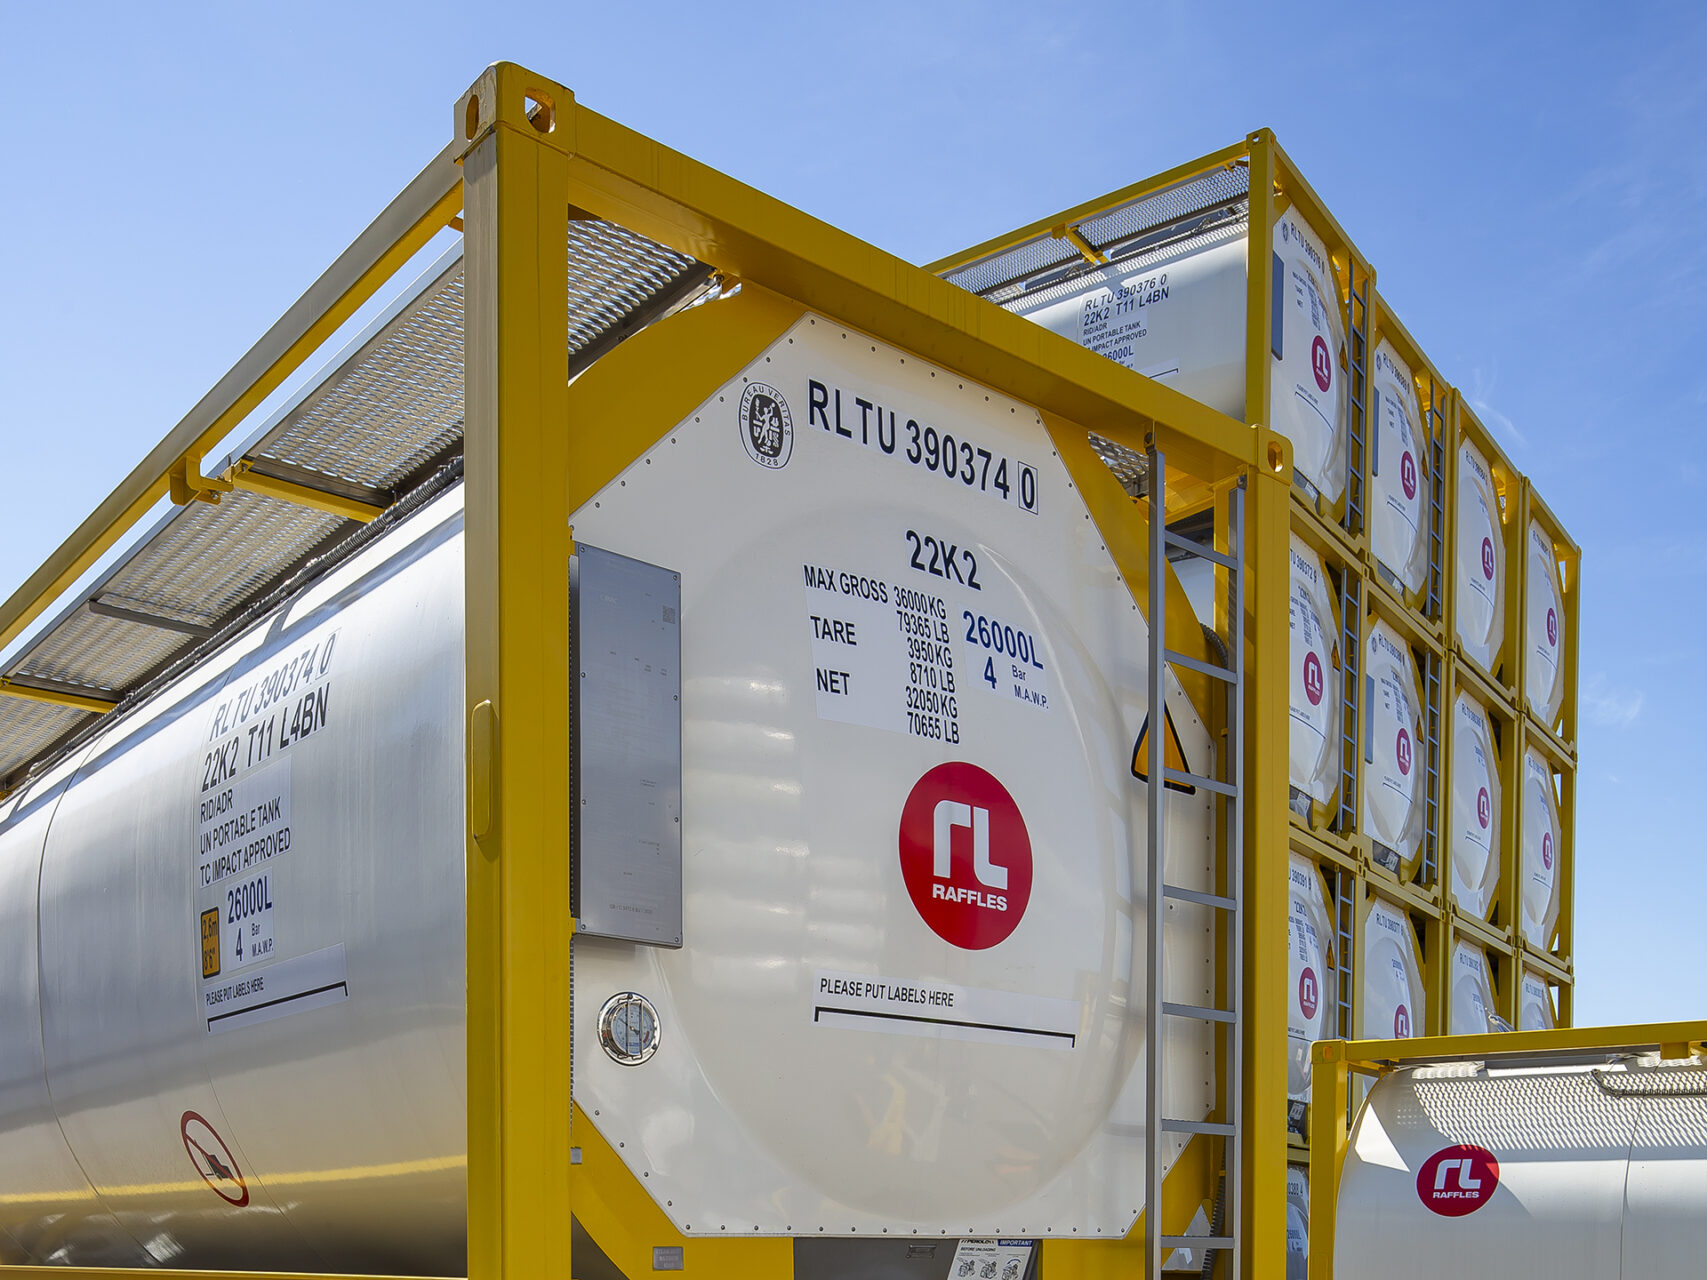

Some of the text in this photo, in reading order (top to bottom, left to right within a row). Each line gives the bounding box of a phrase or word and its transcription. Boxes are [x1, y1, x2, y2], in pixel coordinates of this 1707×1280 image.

[1084, 286, 1169, 327] 22K2 T11 L4BN
[1085, 273, 1167, 311] RLTU 390376 0
[1083, 322, 1107, 336] RID/ADR
[1083, 321, 1141, 346] UN PORTABLE TANK
[1092, 329, 1147, 352] IMPACT APPROVED
[742, 386, 790, 436] BUREAU VERITAS
[755, 453, 779, 466] 1828
[809, 378, 1036, 510] RLTU 390374 0
[906, 529, 982, 591] 22K2
[803, 564, 837, 592] MAX
[840, 572, 889, 604] GROSS
[810, 615, 857, 646] TARE
[896, 610, 950, 644] 79365 LB
[963, 610, 1044, 670] 26000L
[209, 633, 336, 742] RLTU 390374 0
[816, 667, 850, 696] NET
[910, 662, 955, 693] 8710 LB
[984, 656, 1026, 689] 4 Bar
[1014, 684, 1049, 709] M.A.W.P.
[202, 682, 331, 793] 22K2 T11 L4BN
[907, 711, 960, 745] 70655 LB
[200, 788, 233, 824] RID/ADR
[200, 796, 281, 855] UN PORTABLE TANK
[200, 827, 291, 887] TC IMPACT APPROVED
[227, 875, 272, 924] 26000L
[932, 883, 1008, 912] RAFFLES
[235, 922, 260, 962] 4 Bar
[252, 938, 274, 957] M.A.W.P.
[206, 976, 264, 1006] PLEASE PUT LABELS HERE
[820, 977, 954, 1008] PLEASE PUT LABELS HERE
[1433, 1190, 1480, 1199] RAFFLES
